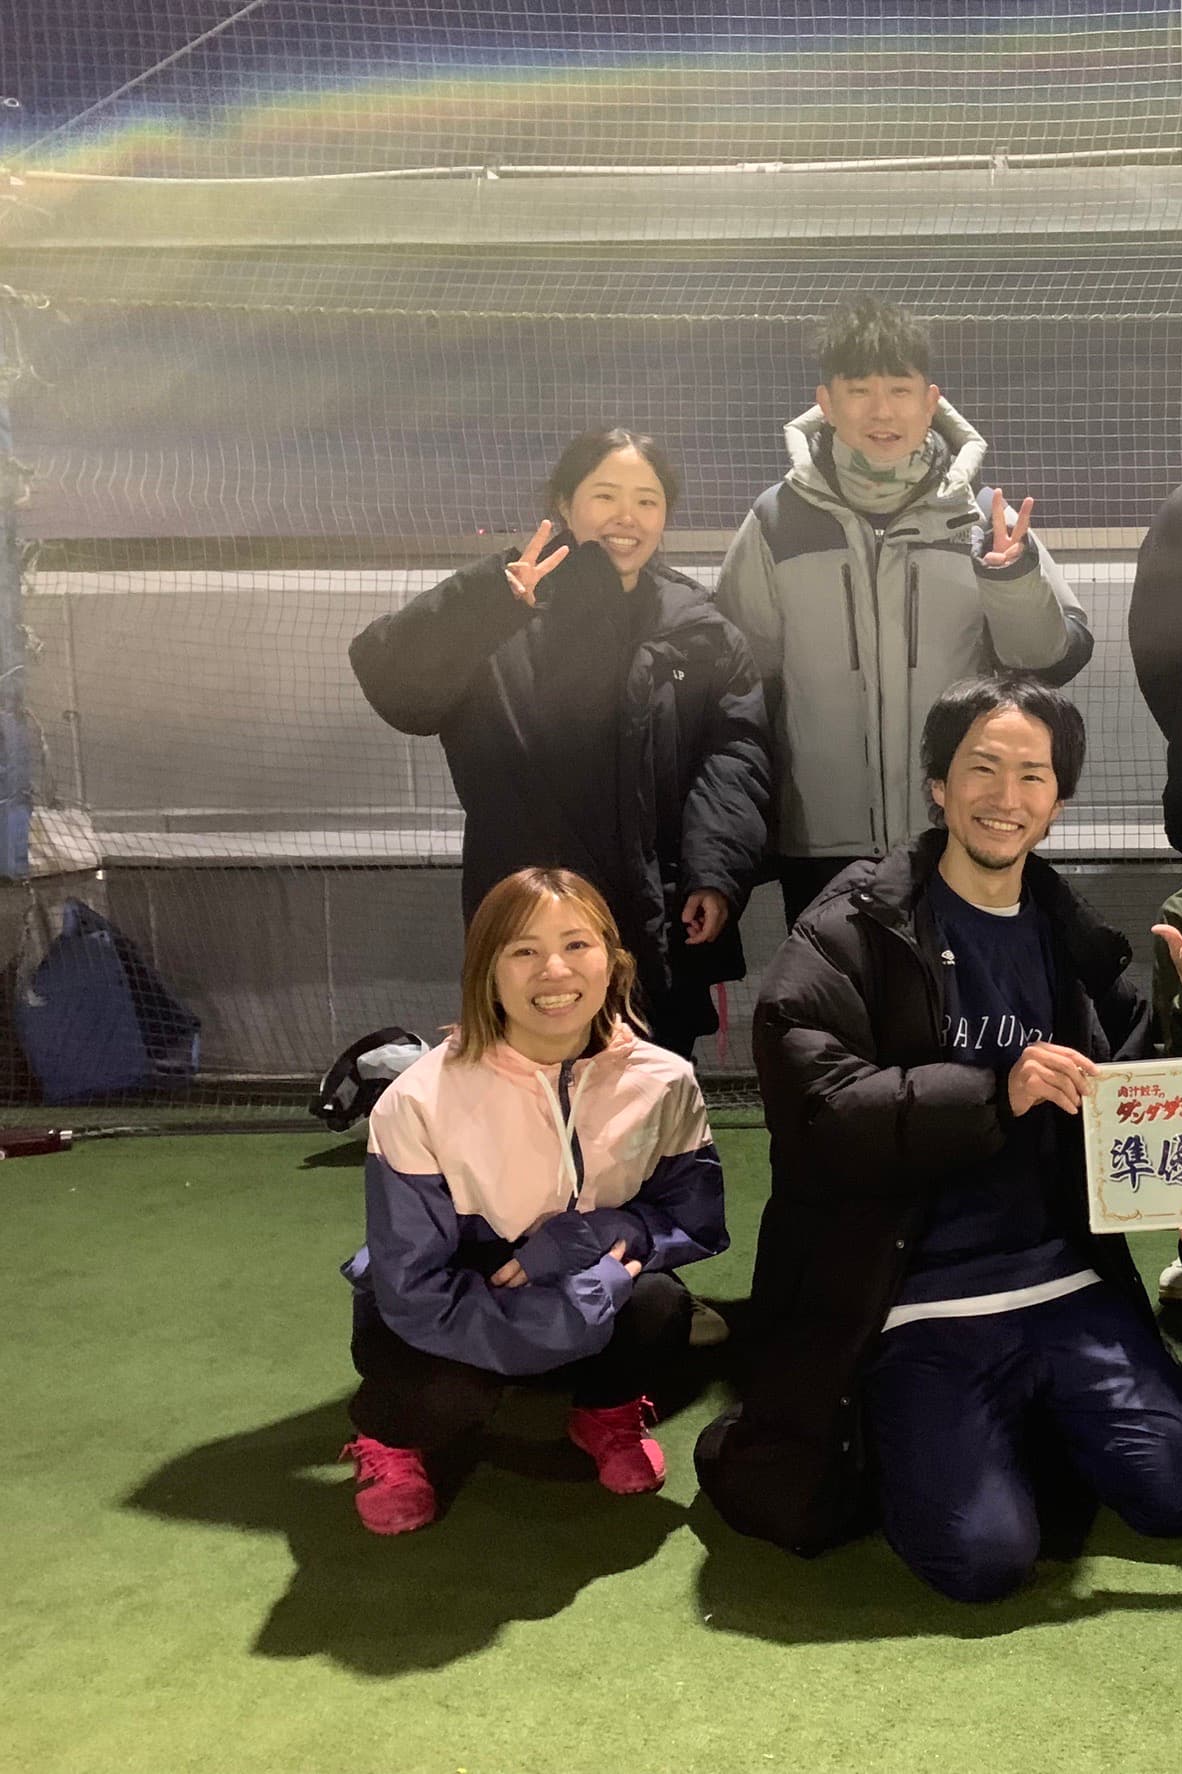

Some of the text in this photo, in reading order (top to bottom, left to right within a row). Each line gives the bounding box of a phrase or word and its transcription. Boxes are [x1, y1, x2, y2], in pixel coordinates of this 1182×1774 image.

[1117, 1084, 1166, 1099] 肉汁餃子の
